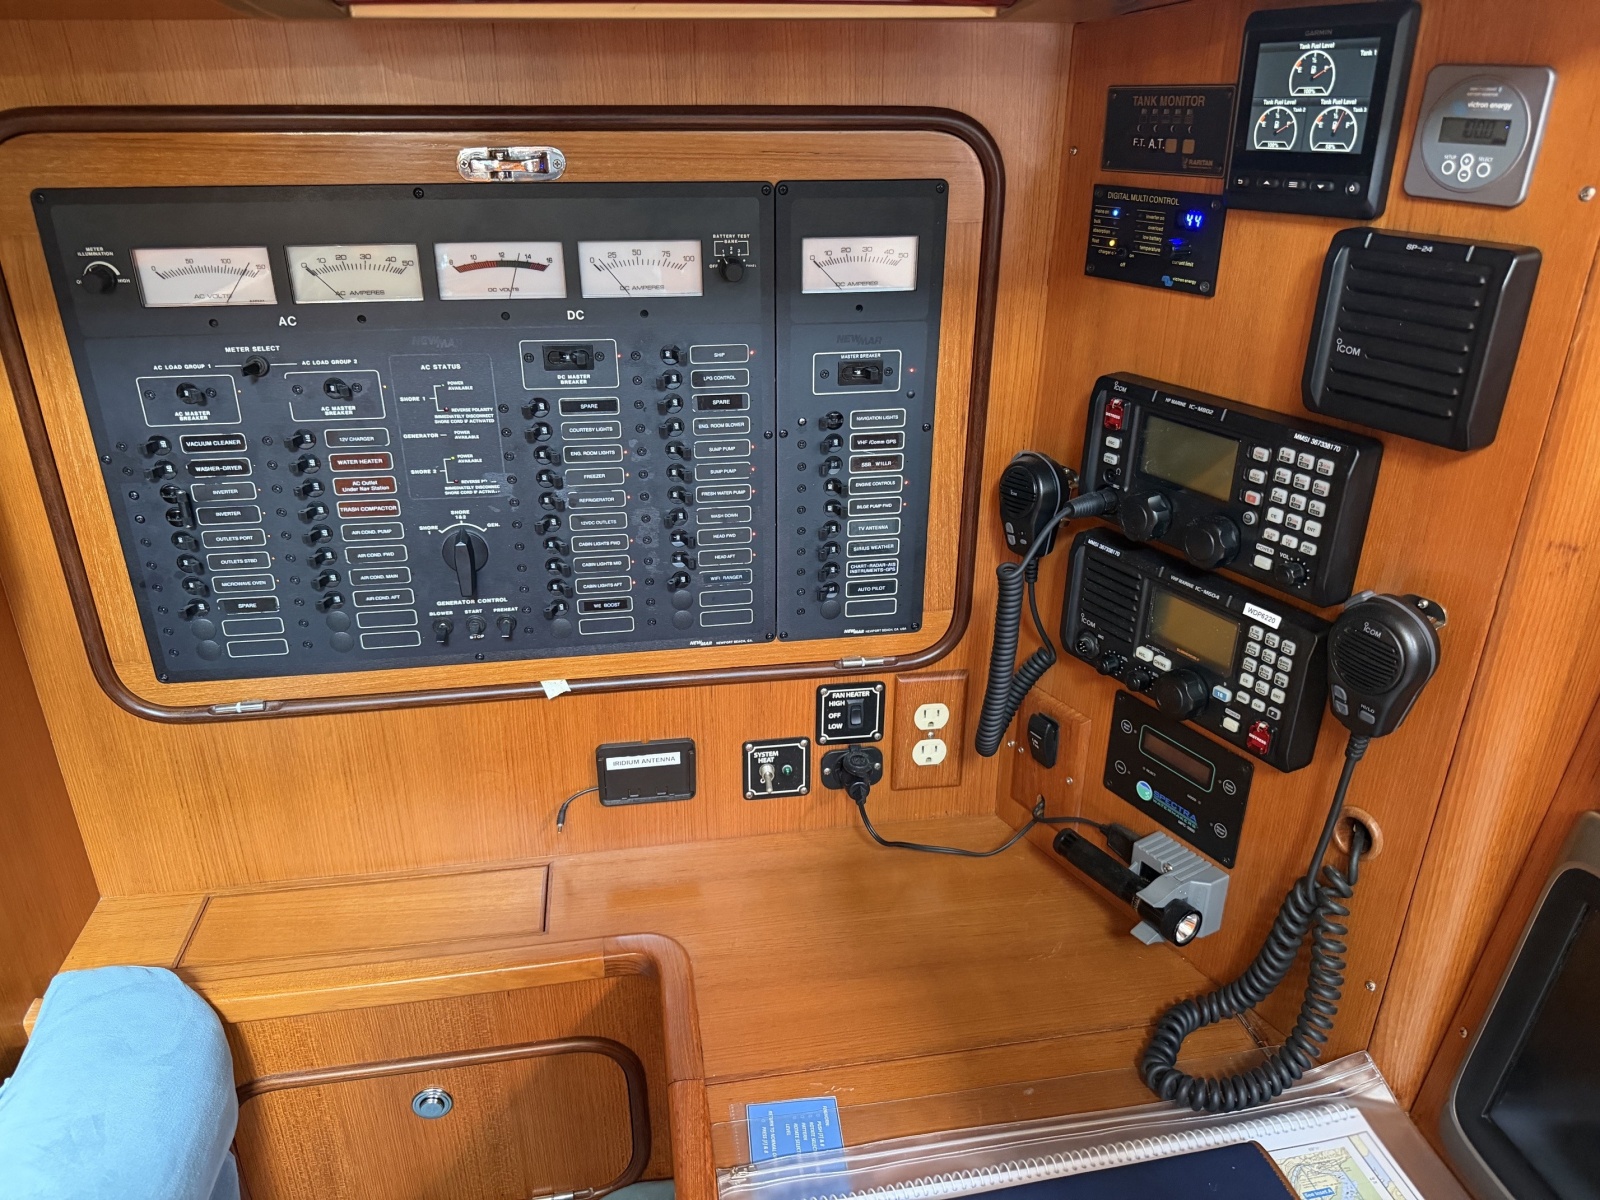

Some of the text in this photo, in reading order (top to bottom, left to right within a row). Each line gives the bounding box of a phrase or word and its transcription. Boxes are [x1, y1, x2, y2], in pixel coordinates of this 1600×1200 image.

[1133, 96, 1205, 107] TANK MONITOR
[1108, 192, 1130, 200] DIGITAL
[1149, 196, 1179, 205] CONTROL
[1406, 244, 1432, 252] SP-24
[567, 310, 584, 320] DC
[279, 316, 297, 326] AC
[1294, 433, 1309, 442] MMSI
[1257, 544, 1273, 554] POWER
[1248, 607, 1276, 624] WDP6220
[1154, 791, 1196, 821] SPECTRA
[1153, 800, 1197, 829] WATERMAKERS
